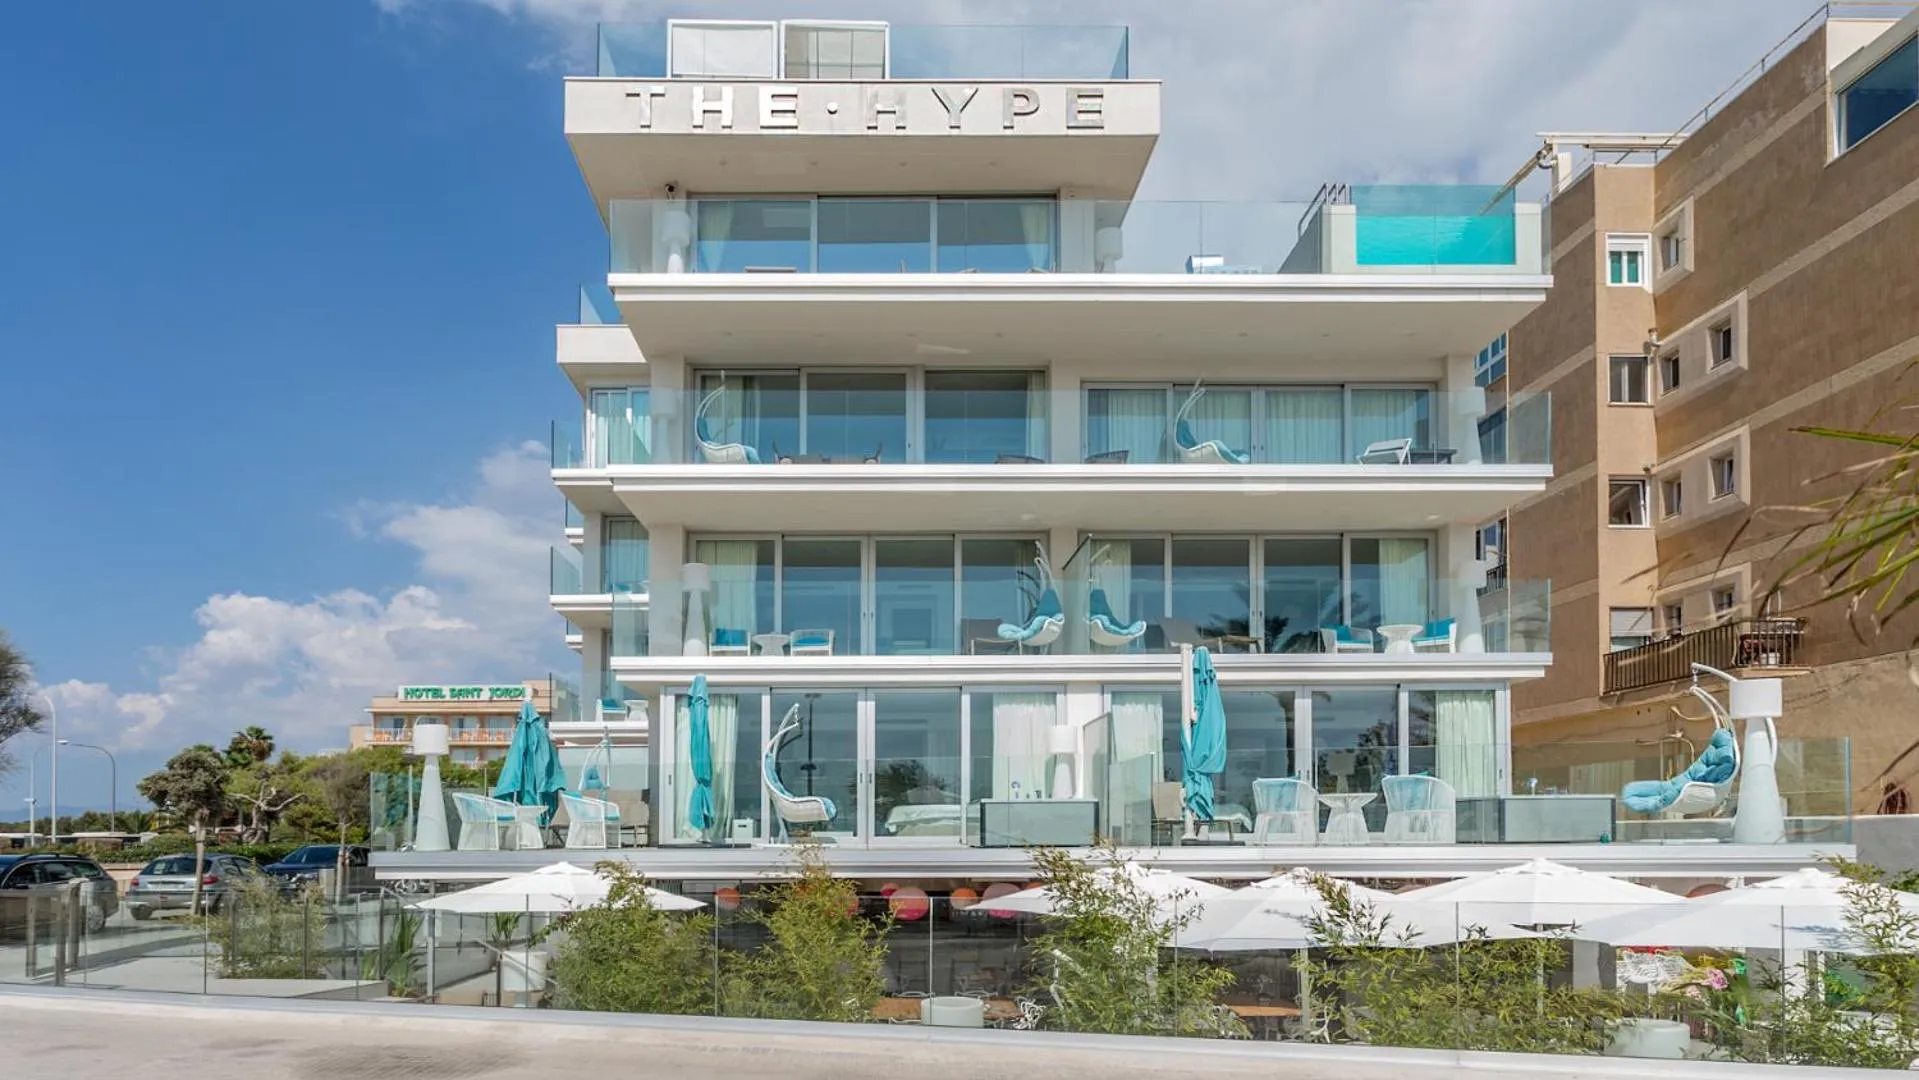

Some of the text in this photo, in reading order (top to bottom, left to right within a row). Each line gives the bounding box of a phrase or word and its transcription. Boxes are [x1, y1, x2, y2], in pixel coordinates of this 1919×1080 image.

[626, 85, 1105, 130] THE HYPE
[403, 687, 446, 700] HOTEL
[449, 687, 483, 699] SANT
